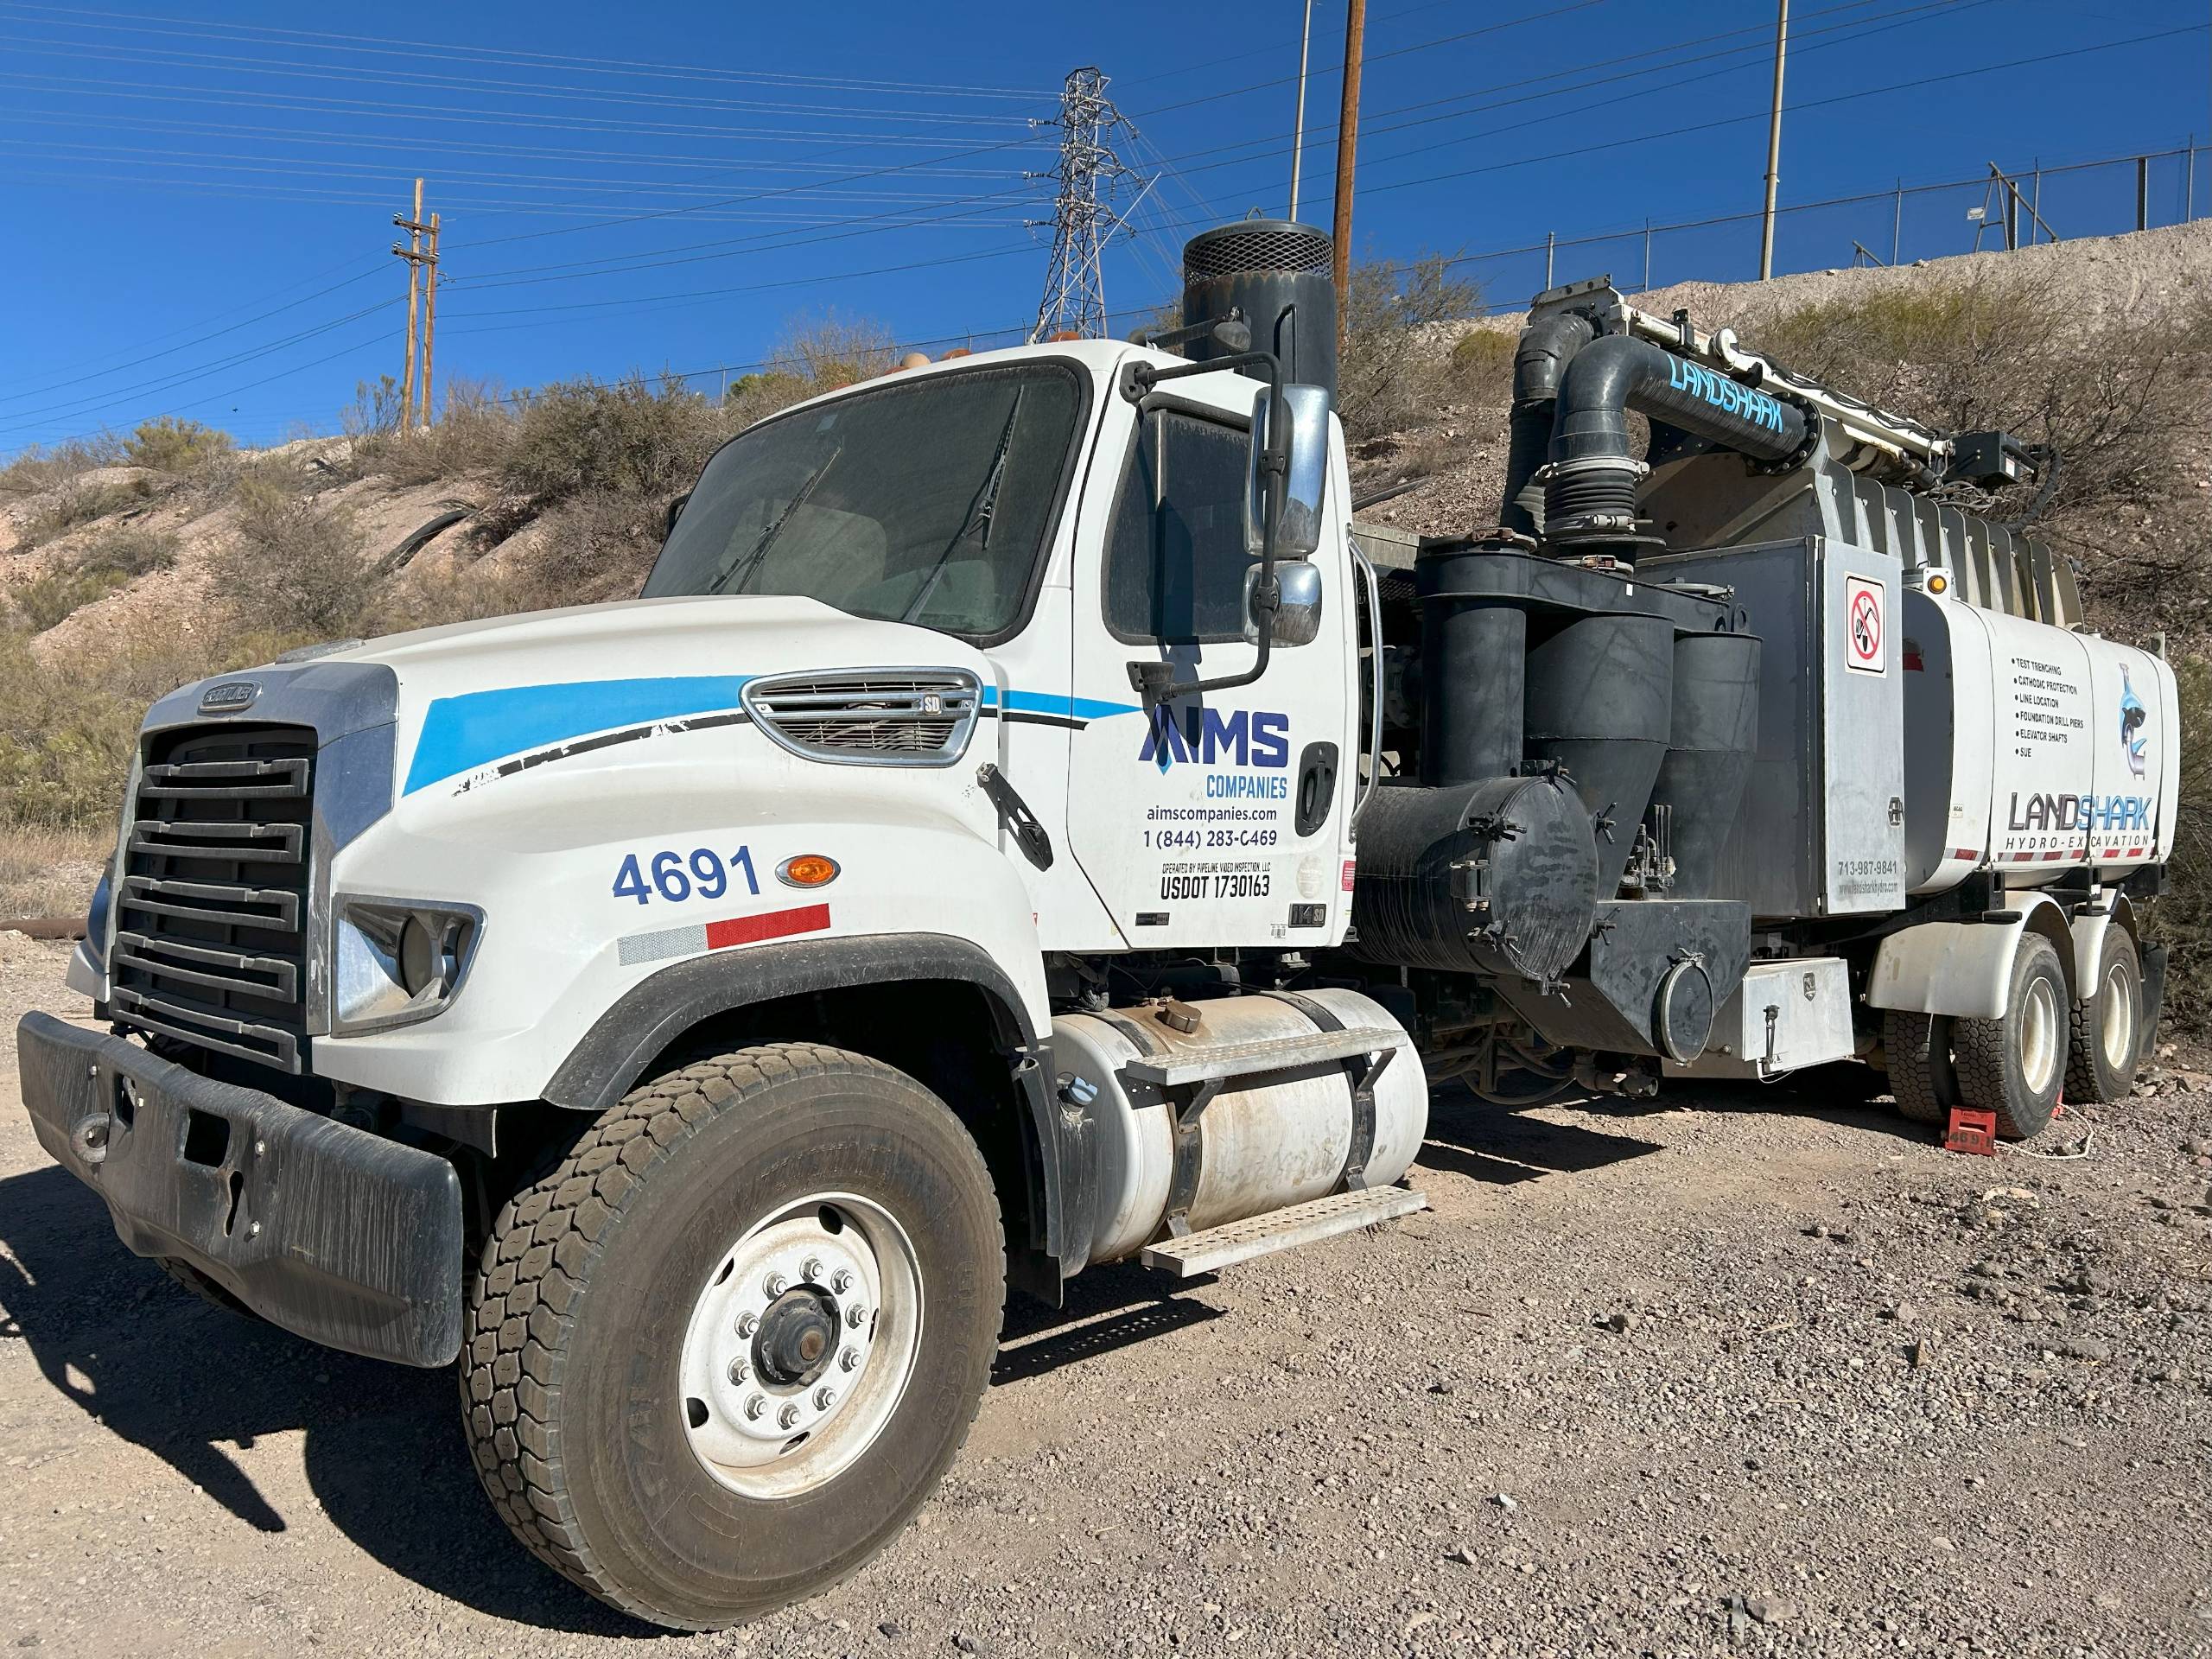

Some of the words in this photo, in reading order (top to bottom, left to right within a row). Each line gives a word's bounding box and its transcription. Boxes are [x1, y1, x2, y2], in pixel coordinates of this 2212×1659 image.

[1667, 354, 1783, 433] LANDSHARK
[2016, 658, 2030, 670] TEST
[2031, 661, 2062, 676] TRENCHING
[2018, 676, 2045, 690] CATHODIC
[2046, 681, 2078, 695] PROTECTION
[924, 696, 940, 713] SD
[2019, 693, 2033, 704] LINE
[2033, 696, 2059, 709] LOCATION
[2020, 711, 2054, 725] FOUNDATION
[2055, 715, 2069, 727] DRILL
[2069, 718, 2084, 728] PIERS
[1138, 703, 1288, 769] AIMS
[2020, 729, 2047, 741] ELEVATOR
[2048, 732, 2068, 743] SHAFTS
[2019, 747, 2031, 758] SUE
[1206, 774, 1287, 799] COMPANIES
[1147, 805, 1277, 823] aimscompanies.com
[2008, 791, 2152, 831] LANDSHARK
[1143, 830, 1150, 848] 1
[1156, 830, 1201, 850] (844)
[612, 845, 760, 905] 4691
[1162, 863, 1188, 874] OPERATED
[1189, 862, 1196, 874] BY
[1197, 862, 1218, 873] PIPELINE
[1219, 862, 1234, 873] VIDEO
[1262, 861, 1271, 872] LLC
[1838, 860, 1897, 875] 713-987-9841
[1160, 876, 1210, 899] USDOT
[1214, 874, 1270, 899] 1730163
[1313, 908, 1324, 922] SD
